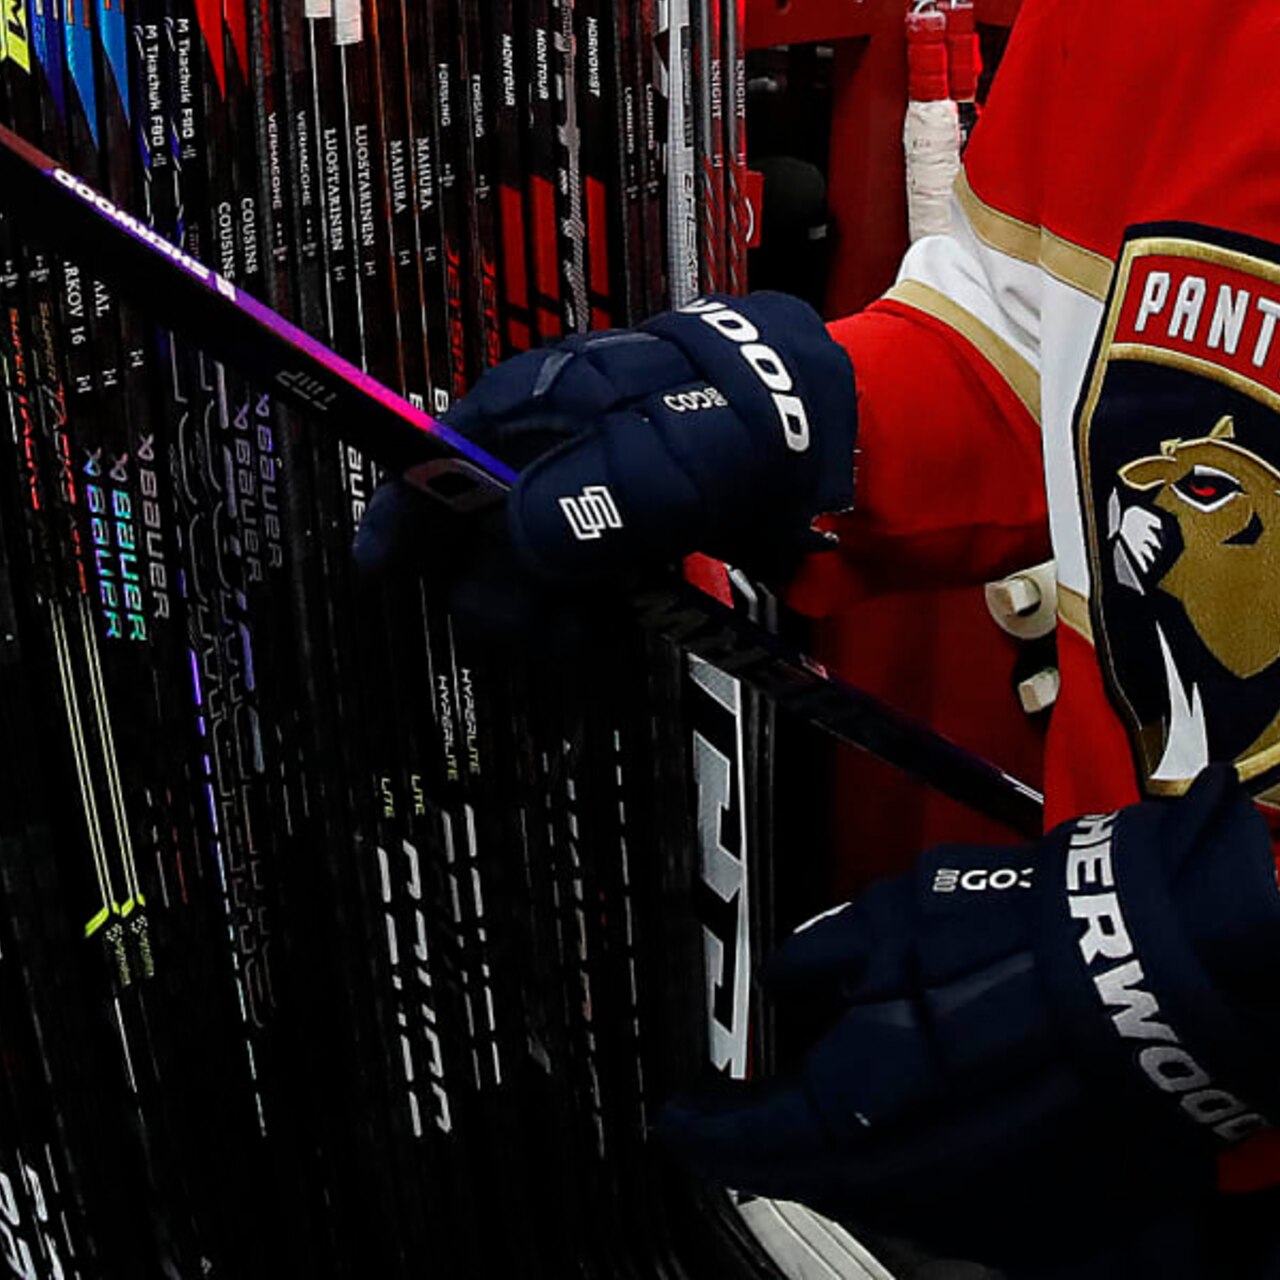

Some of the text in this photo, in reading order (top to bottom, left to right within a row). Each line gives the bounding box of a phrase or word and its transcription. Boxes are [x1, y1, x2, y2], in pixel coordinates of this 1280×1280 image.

[323, 127, 345, 252] LUOSTARINEN
[355, 123, 376, 247] LUOSTARINEN
[390, 139, 409, 215] MAHURA
[416, 137, 435, 212] MAHURA
[219, 203, 237, 280] COUSINS
[239, 196, 260, 276] COUSINS
[71, 326, 88, 346] 16
